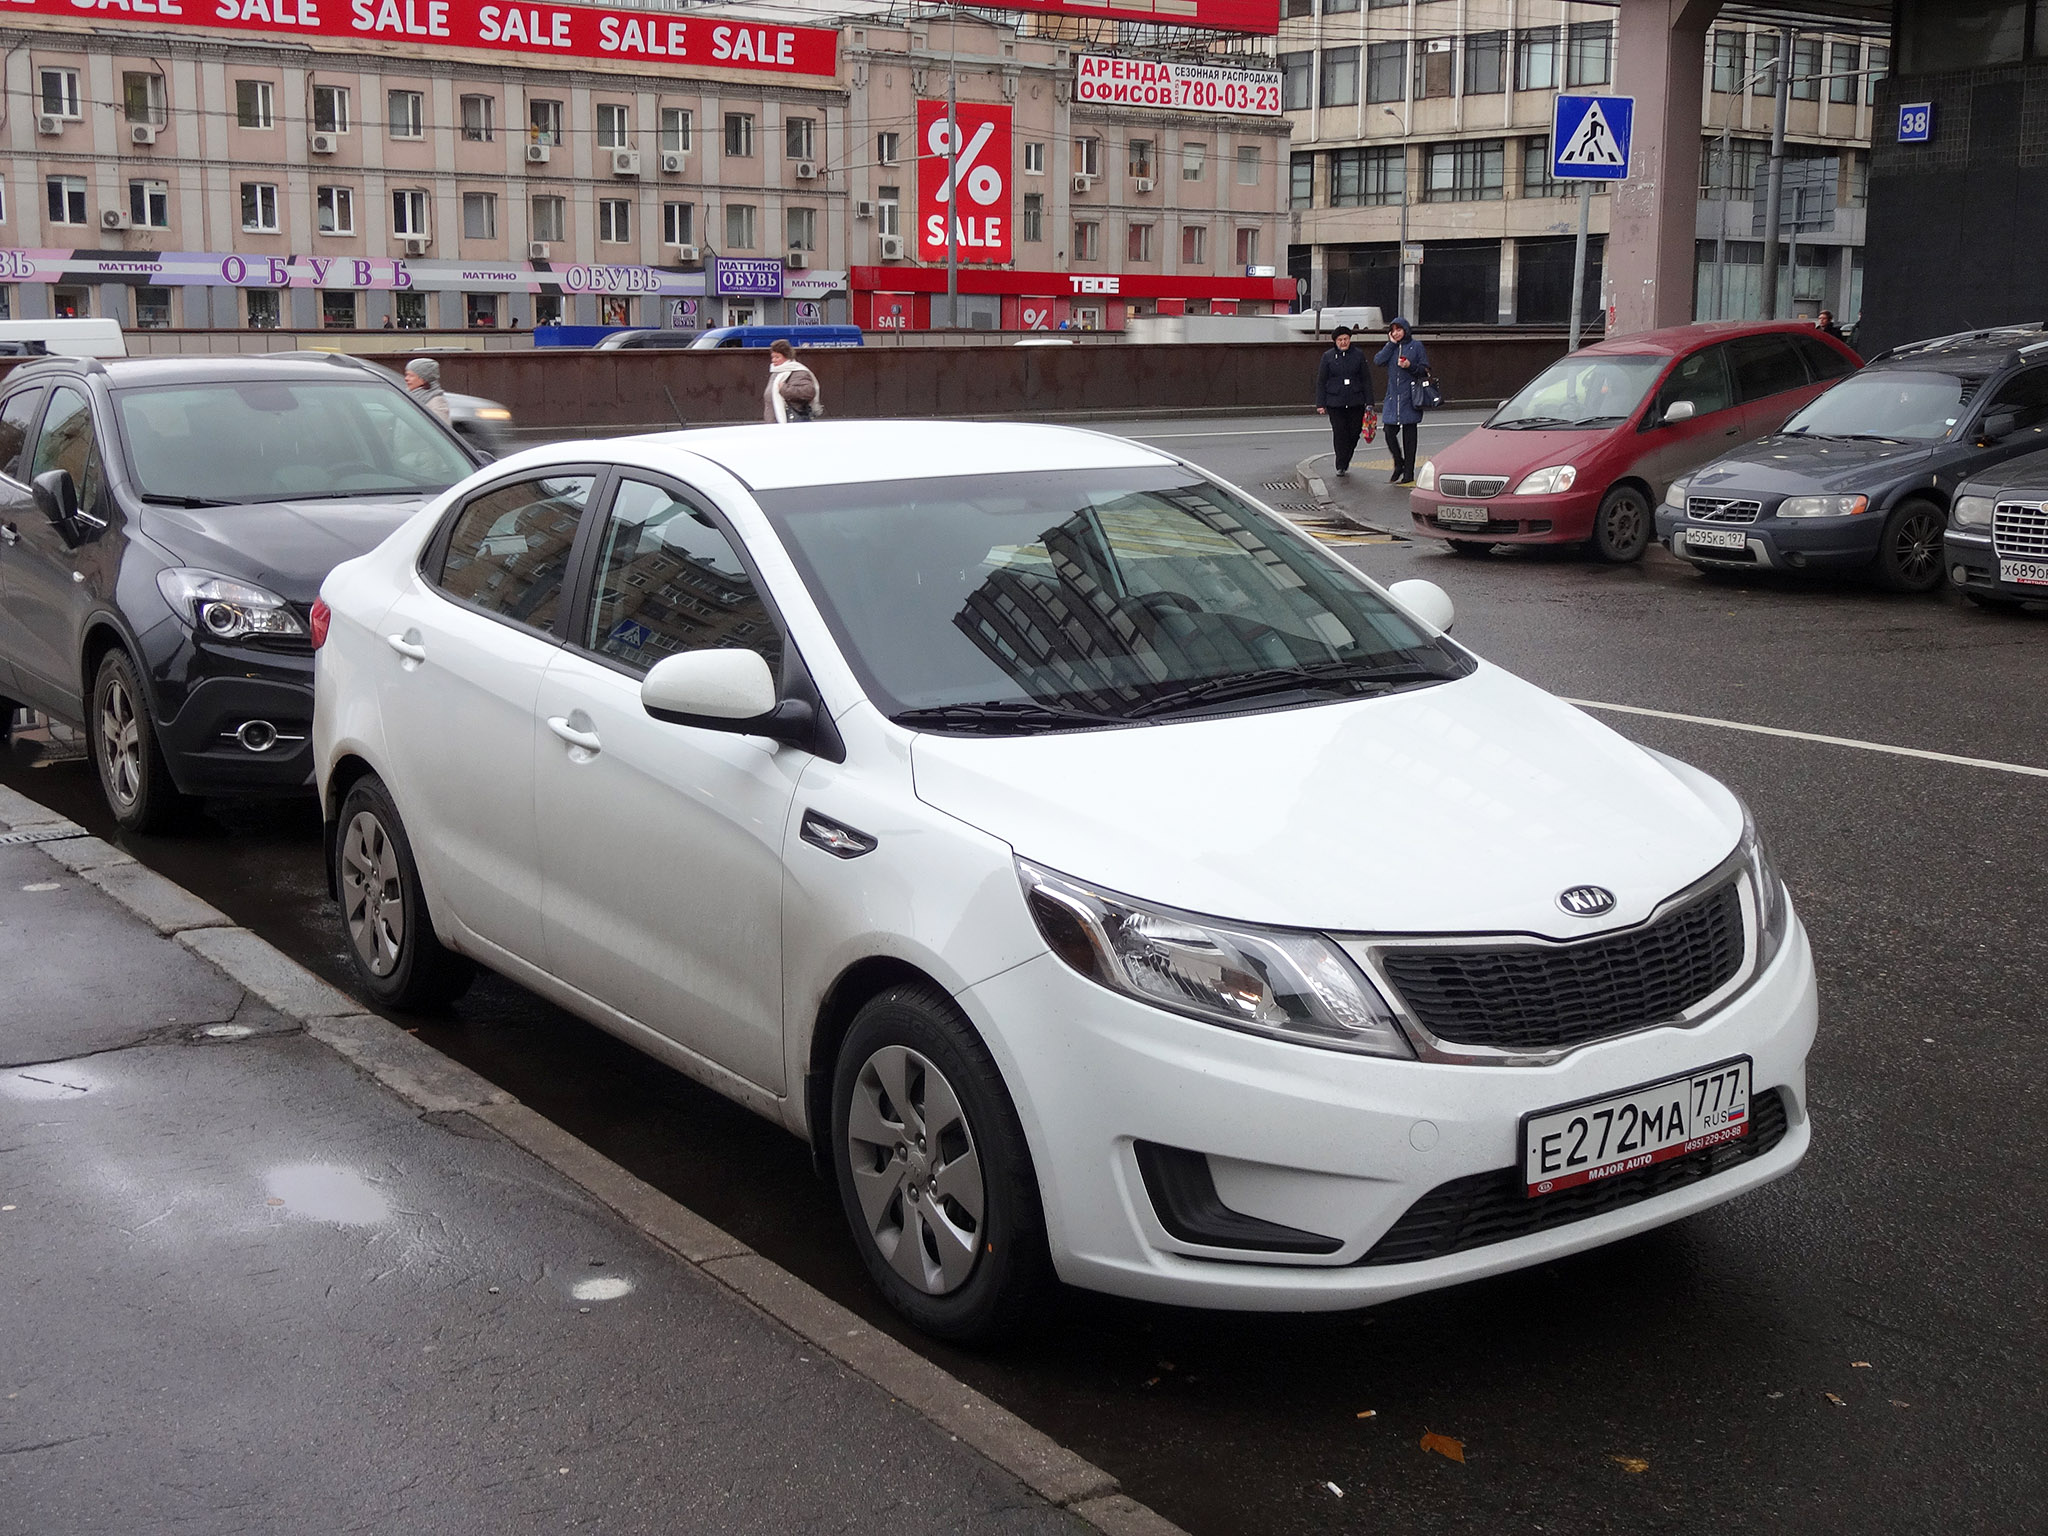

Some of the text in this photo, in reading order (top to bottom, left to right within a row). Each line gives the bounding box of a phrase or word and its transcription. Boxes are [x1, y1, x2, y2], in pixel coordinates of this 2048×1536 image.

[352, 0, 450, 36] SALE
[479, 6, 572, 47] SALE
[599, 16, 687, 56] SALE
[711, 26, 795, 64] SALE
[1081, 58, 1171, 85] АРЕНДА
[1175, 66, 1279, 84] СЕЗОННАЯ РАСПРОДАЖА
[1080, 81, 1172, 105] ОФИСОВ
[1181, 80, 1279, 111] 780-03-23
[1902, 112, 1926, 133] 38
[927, 215, 1002, 247] SALE
[99, 263, 163, 272] МАТТИНО
[221, 255, 412, 287] ОБУВЬ
[462, 271, 517, 280] МАТТИНО
[720, 262, 779, 271] МАТТИНО
[567, 265, 662, 291] ОБУВЬ
[723, 272, 777, 286] ОБУВЬ
[791, 280, 838, 288] МАТТИНО
[1727, 533, 1742, 543] 197
[1564, 888, 1613, 911] KIA
[1694, 1068, 1740, 1117] 777
[1704, 1110, 1728, 1129] RUS
[1684, 1138, 1704, 1153] (495)
[1588, 1154, 1653, 1180] MAJOR AUTO
